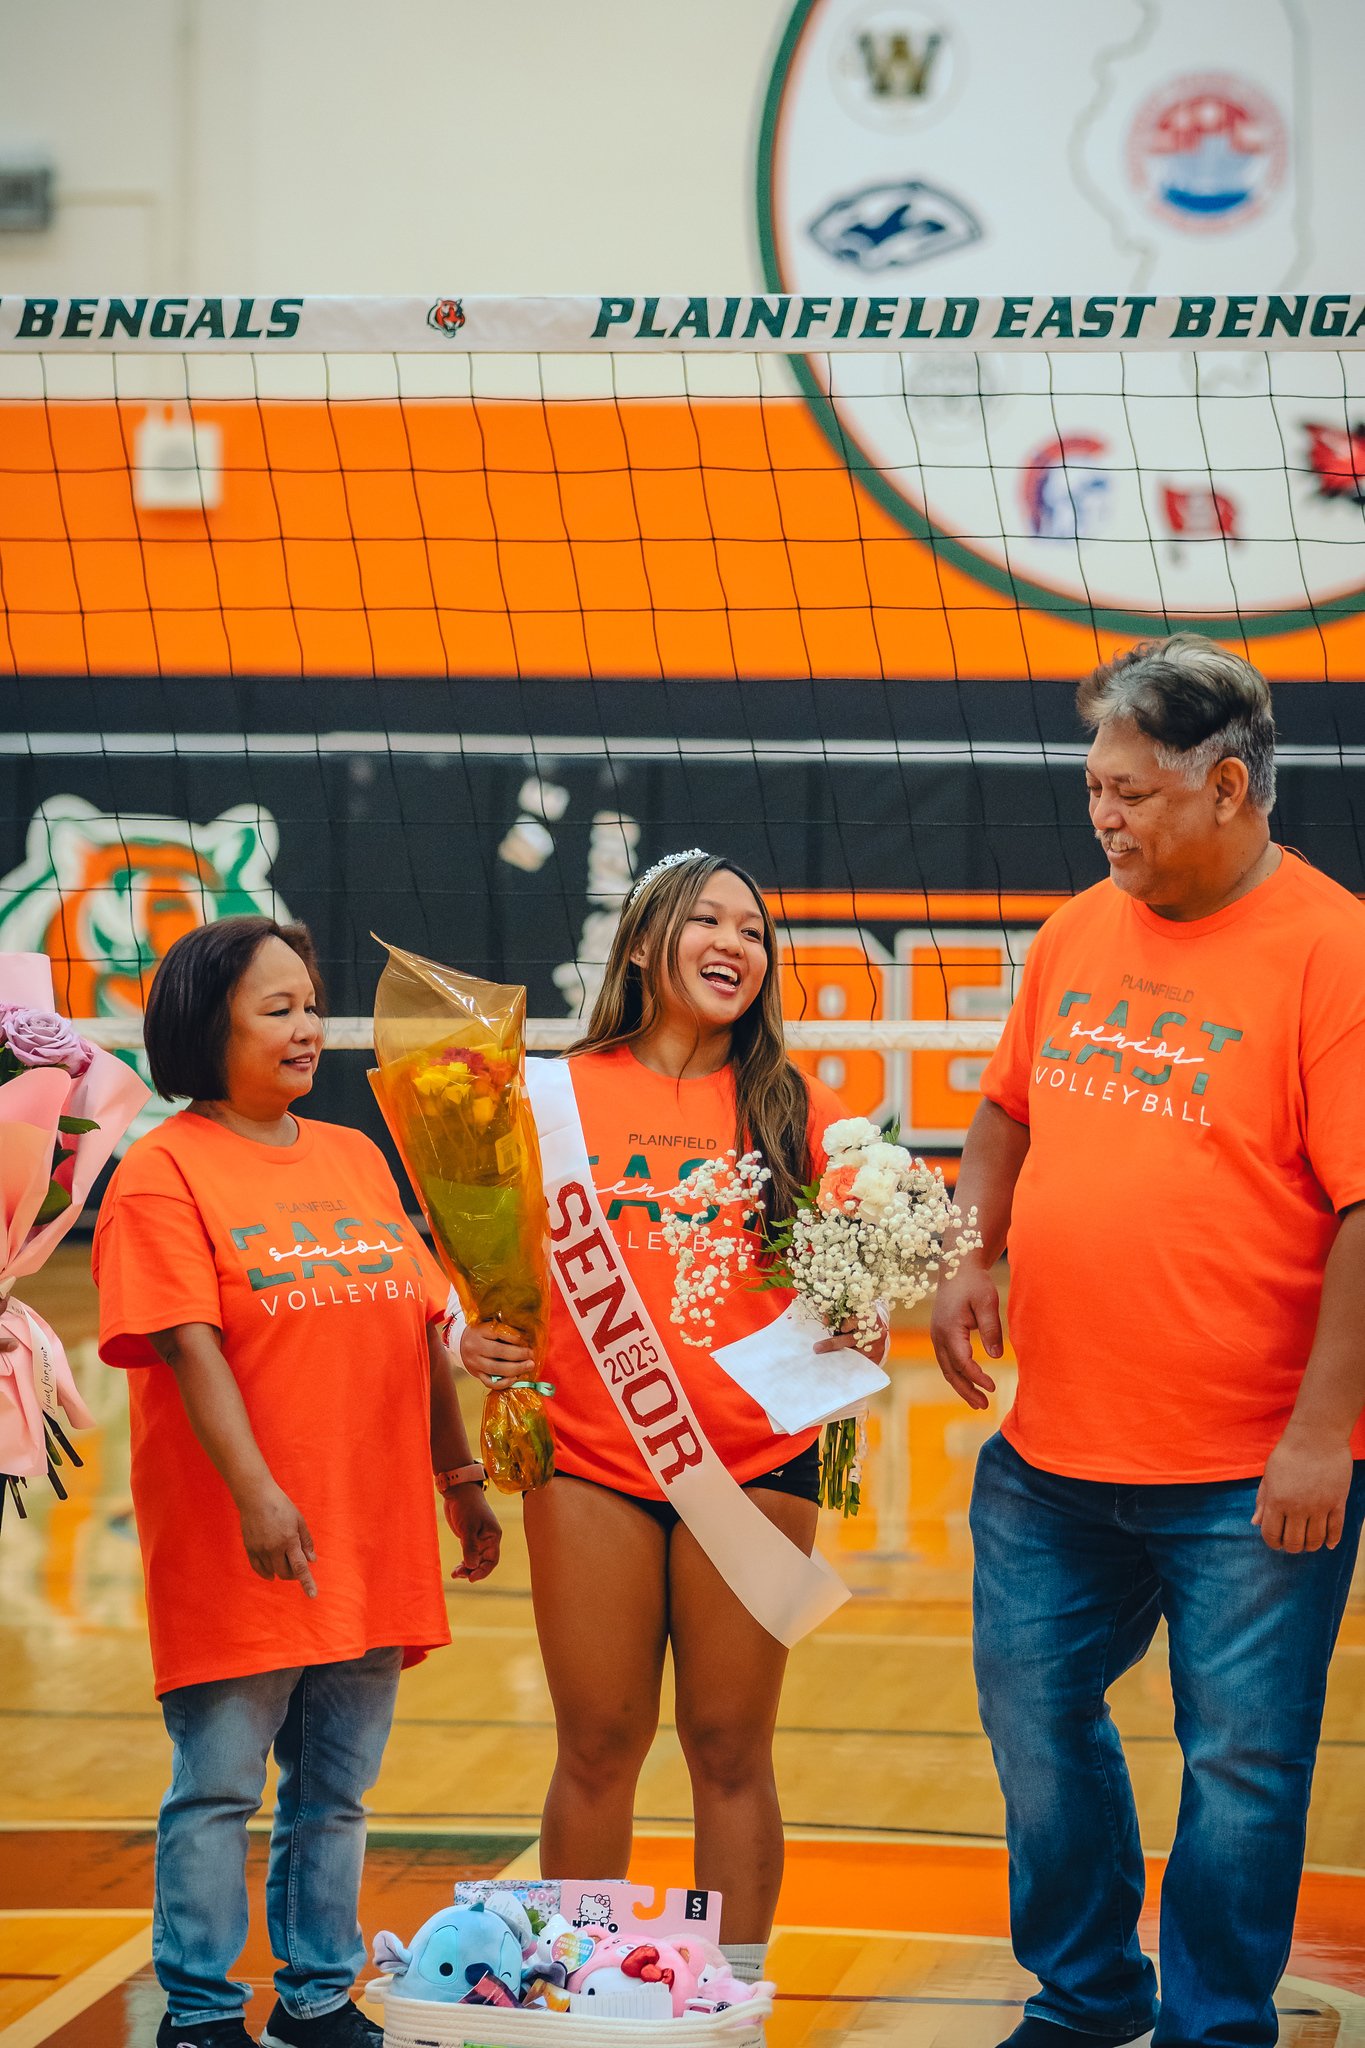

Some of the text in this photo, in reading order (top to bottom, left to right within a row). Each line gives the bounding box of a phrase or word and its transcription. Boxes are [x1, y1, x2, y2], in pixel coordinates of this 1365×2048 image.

[15, 298, 304, 338] BENGALS
[590, 297, 980, 338] PLAINFIELD
[991, 296, 1157, 338] EAST
[1121, 974, 1195, 1003] PLAINFIELD
[1040, 990, 1243, 1096] EAST
[1069, 1021, 1205, 1063] senior
[1035, 1065, 1211, 1127] VOLLEYBALL
[628, 1133, 717, 1150] PLAINFIELD
[275, 1200, 347, 1214] PLAINFIELD
[230, 1217, 423, 1291] EAST
[269, 1239, 404, 1262] senior
[603, 1336, 659, 1385] 2025
[41, 1350, 56, 1414] Just for you
[691, 1897, 702, 1913] S
